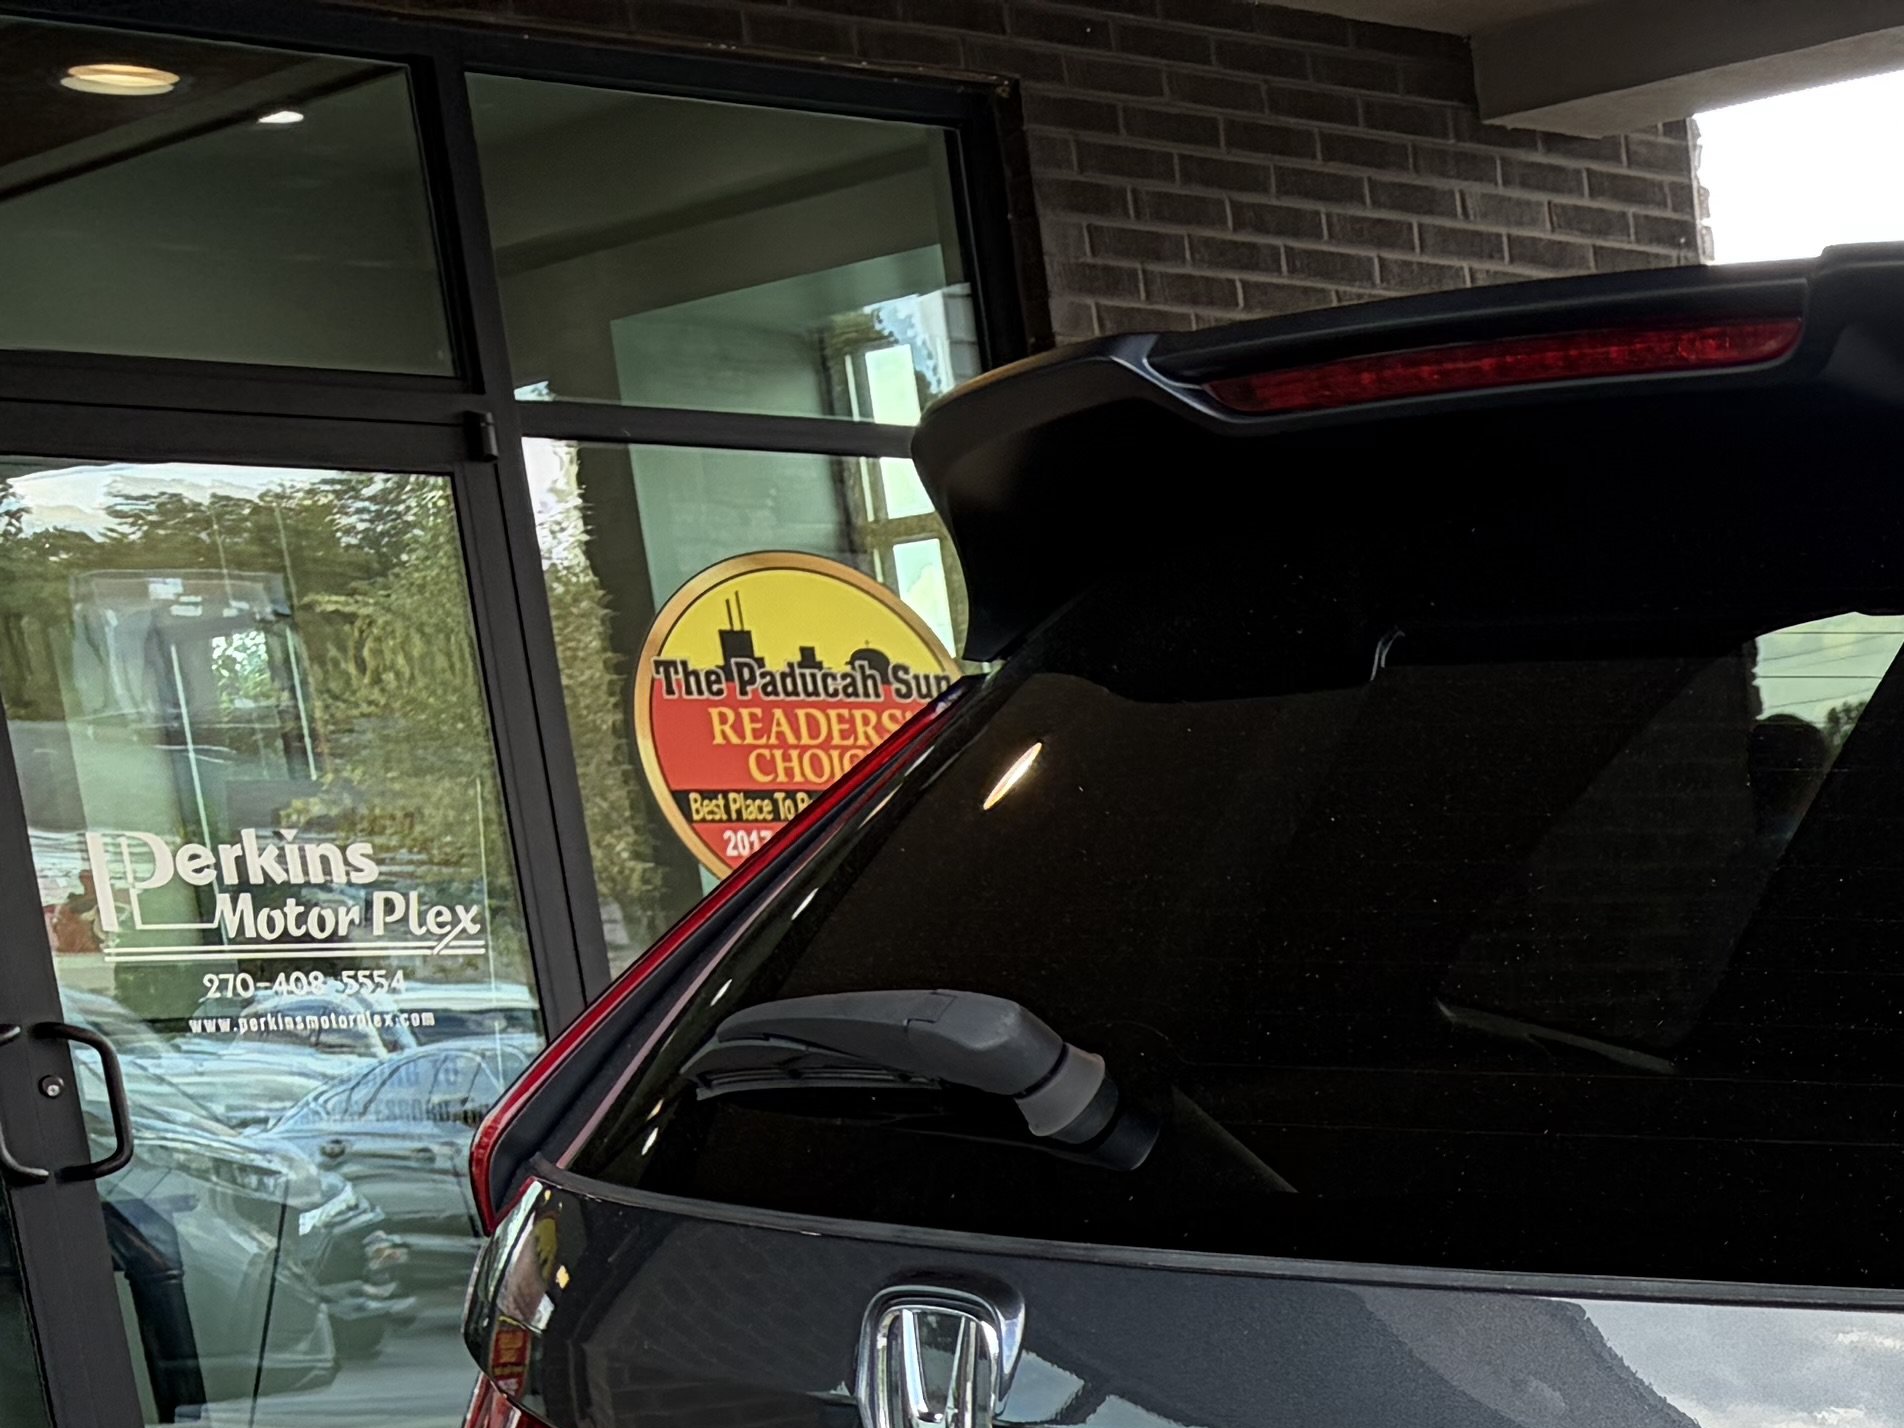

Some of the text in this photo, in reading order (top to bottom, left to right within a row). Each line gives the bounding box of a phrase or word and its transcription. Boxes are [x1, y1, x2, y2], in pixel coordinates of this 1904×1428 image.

[653, 657, 725, 699] The
[730, 657, 882, 700] Paducah
[689, 792, 728, 820] Best
[728, 792, 774, 820] Place
[87, 828, 380, 932] Perkins
[217, 890, 481, 953] Motor Plex
